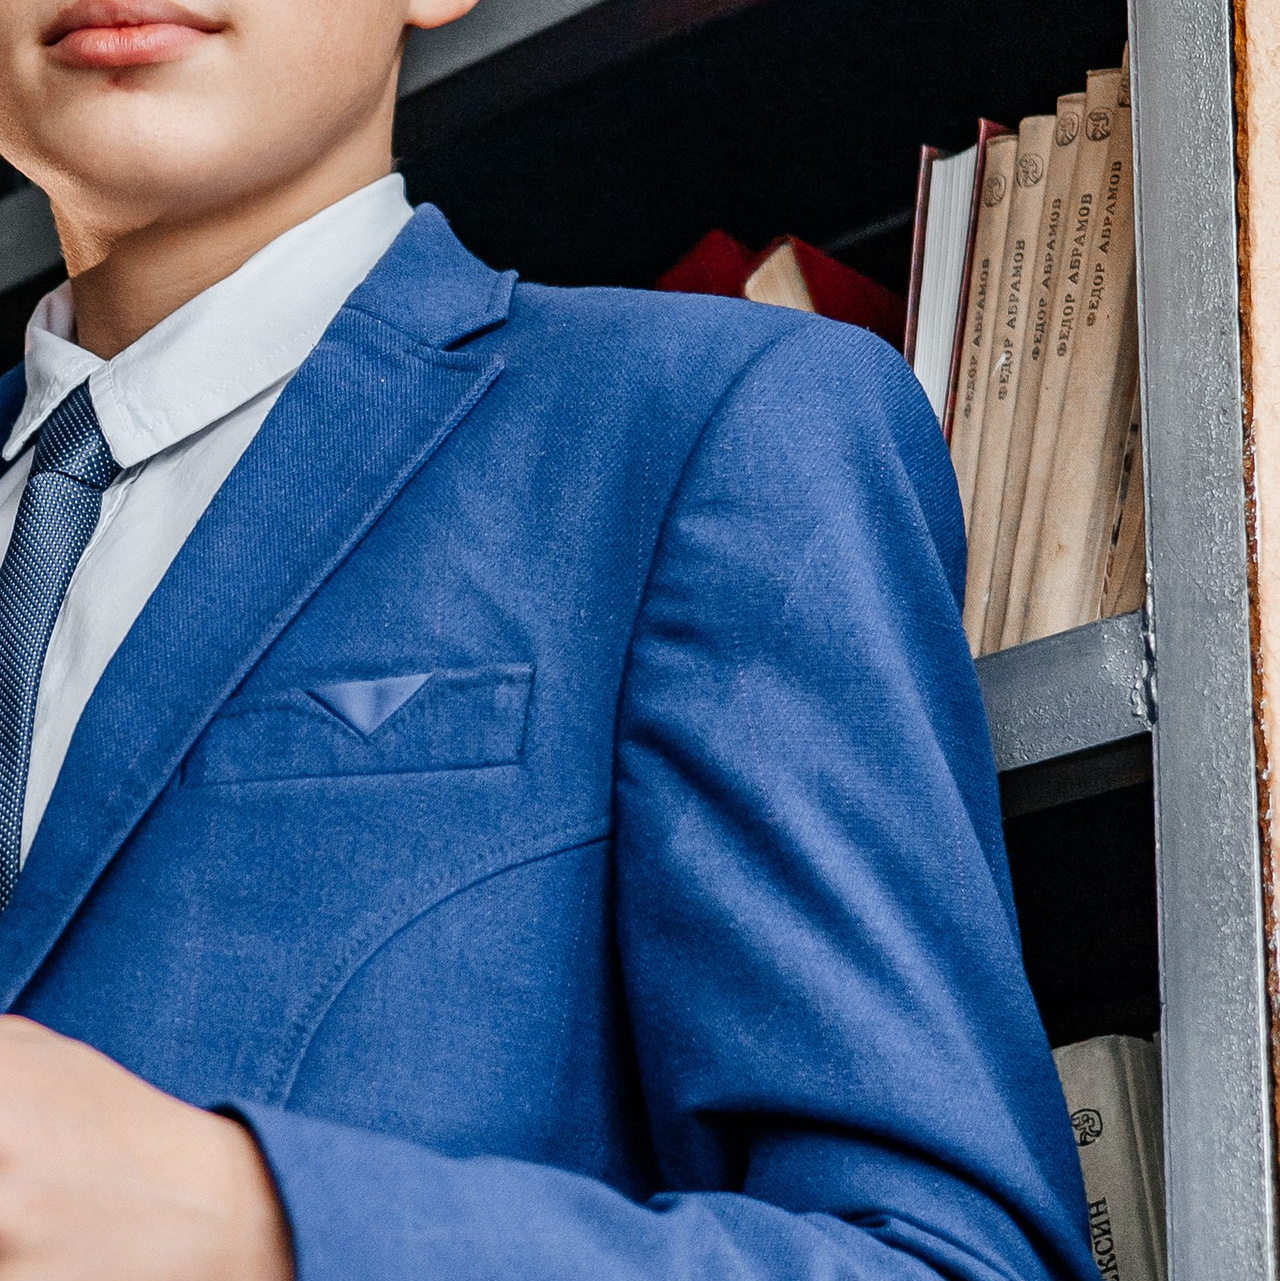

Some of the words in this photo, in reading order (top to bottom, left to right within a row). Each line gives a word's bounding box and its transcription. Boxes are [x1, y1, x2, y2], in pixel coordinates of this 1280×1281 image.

[998, 337, 1014, 401] ФЕДОР
[1006, 239, 1027, 330] АБРАМОВ
[1031, 297, 1048, 361] ФЕДОР
[1042, 197, 1062, 289] АБРАМОВ
[1057, 293, 1076, 357] ФЕДОР
[1067, 193, 1093, 285] АБРАМОВ
[1086, 262, 1106, 327] ФЕДОР
[1098, 160, 1122, 255] АБРАМОВ
[963, 354, 979, 420] ФЕДОР
[972, 258, 990, 348] АБРАМОВ
